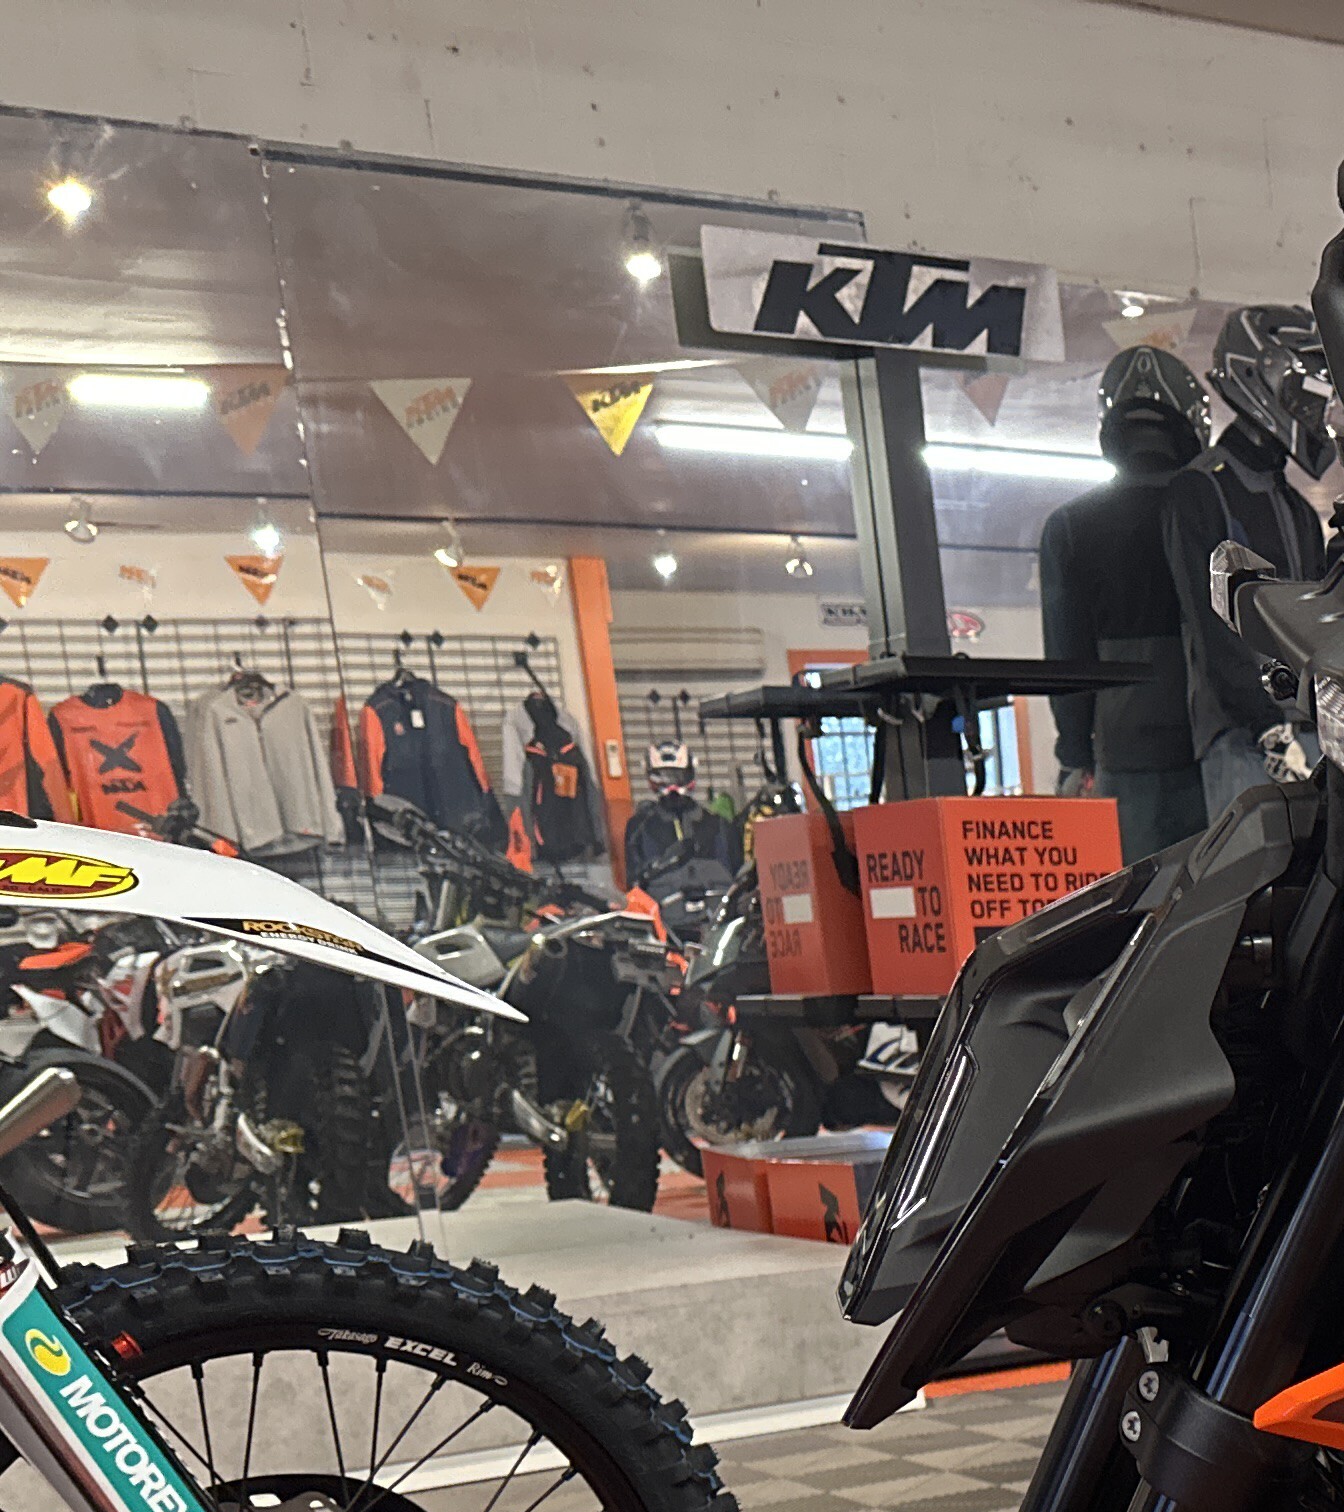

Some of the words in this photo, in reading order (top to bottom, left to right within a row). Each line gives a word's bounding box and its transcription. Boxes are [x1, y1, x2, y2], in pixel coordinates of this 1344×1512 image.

[753, 243, 1027, 357] KTM
[962, 820, 1053, 840] FINANCE
[866, 850, 924, 883] READY
[964, 847, 1027, 866] WHAT
[1034, 847, 1077, 865] YOU
[0, 857, 132, 888] MF
[967, 873, 1024, 893] NEED
[1031, 873, 1058, 891] TO
[1065, 873, 1113, 892] RID
[917, 886, 941, 917] TO
[970, 900, 1011, 919] OFF
[898, 922, 946, 953] RACE
[384, 1336, 457, 1366] EXCEL
[467, 1362, 501, 1384] Rim
